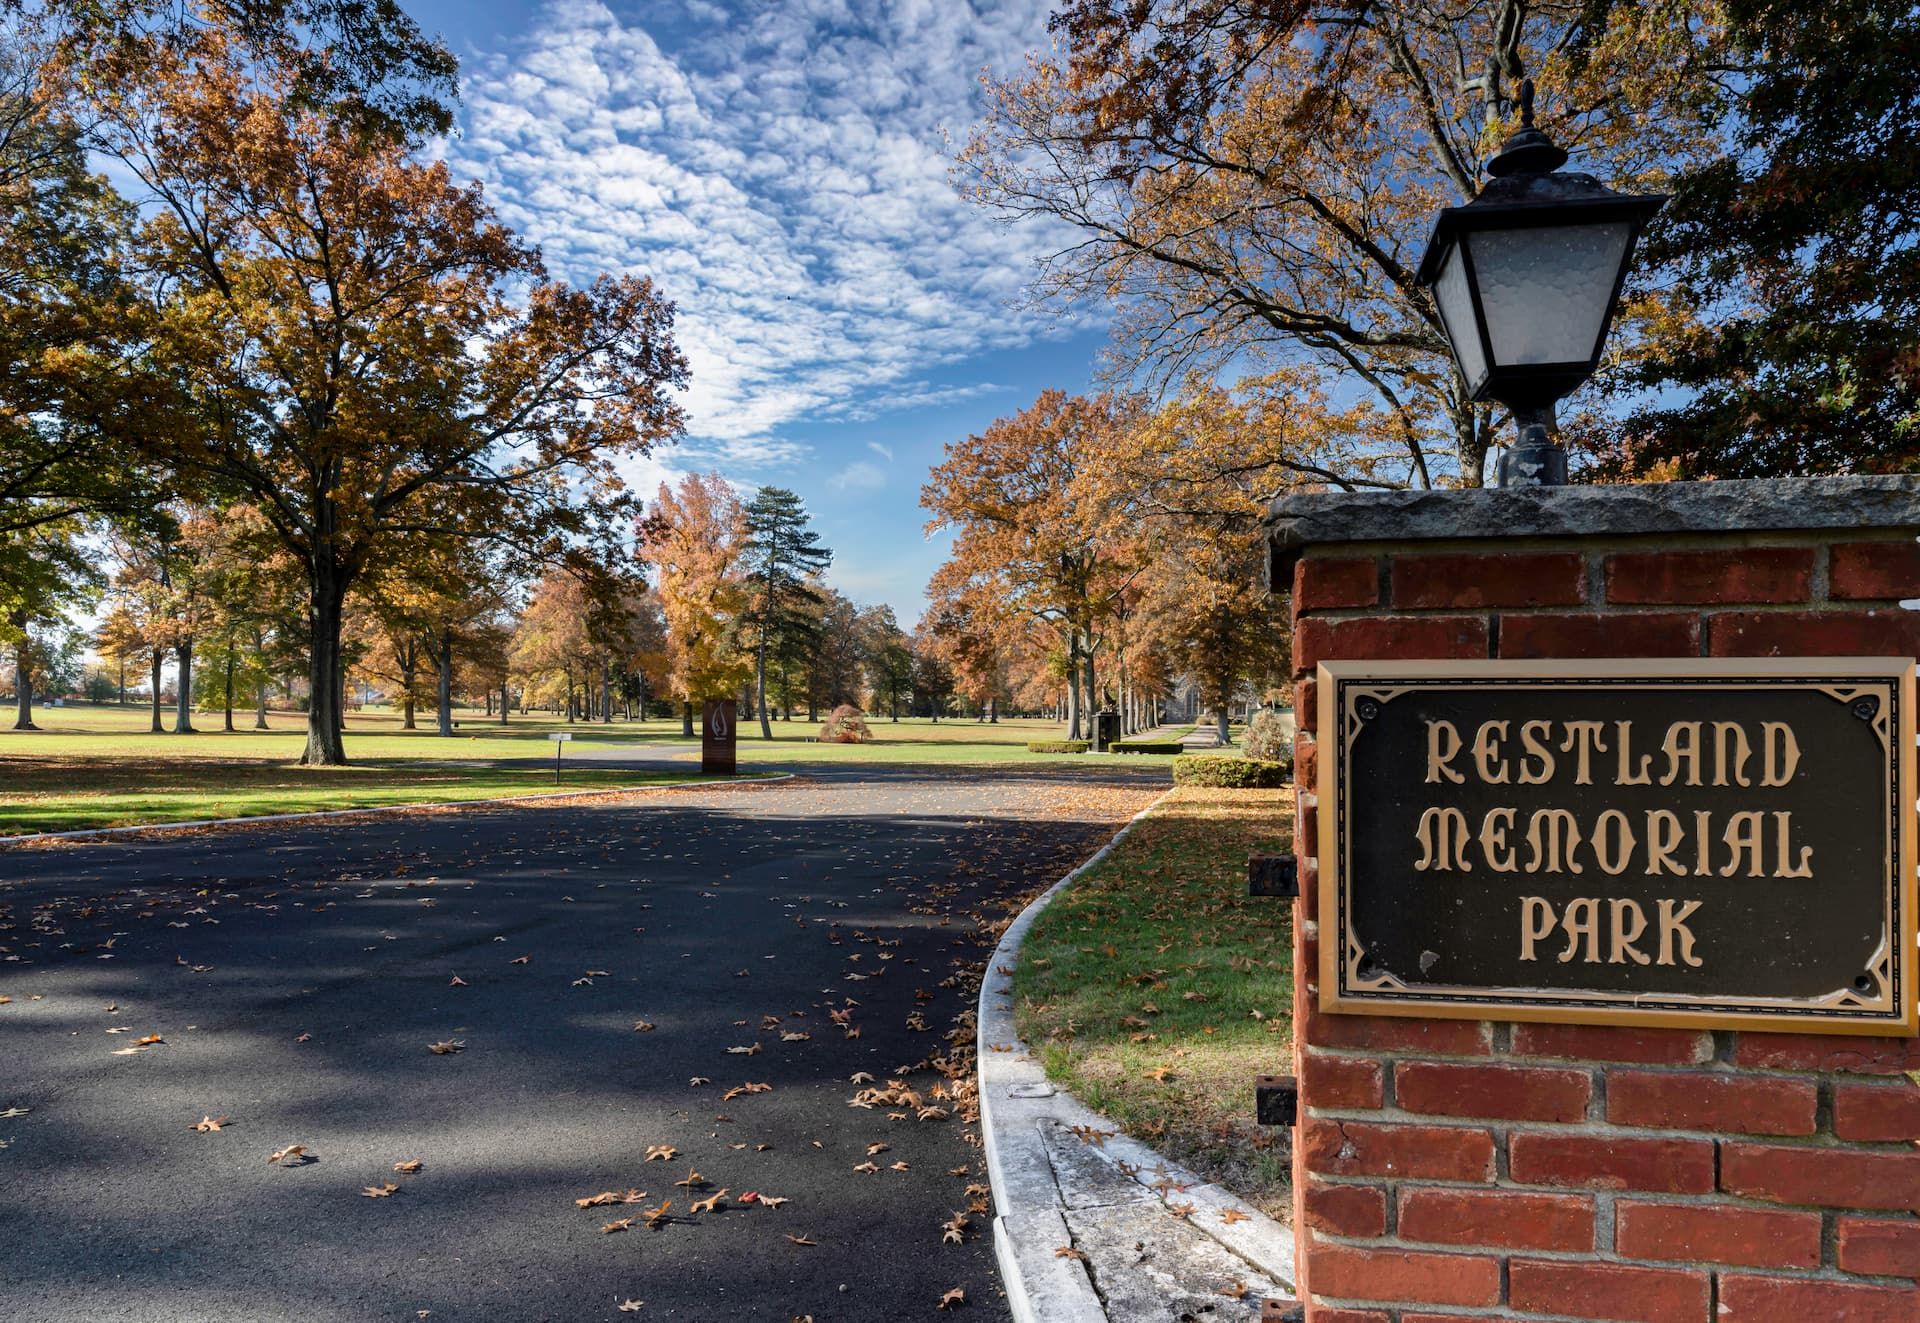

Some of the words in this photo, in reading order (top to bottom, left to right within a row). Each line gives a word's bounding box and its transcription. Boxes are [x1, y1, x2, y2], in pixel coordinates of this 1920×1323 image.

[1423, 719, 1801, 787] RESTLAND
[1414, 806, 1813, 878] MEMORIAL
[1519, 896, 1703, 967] PARK
